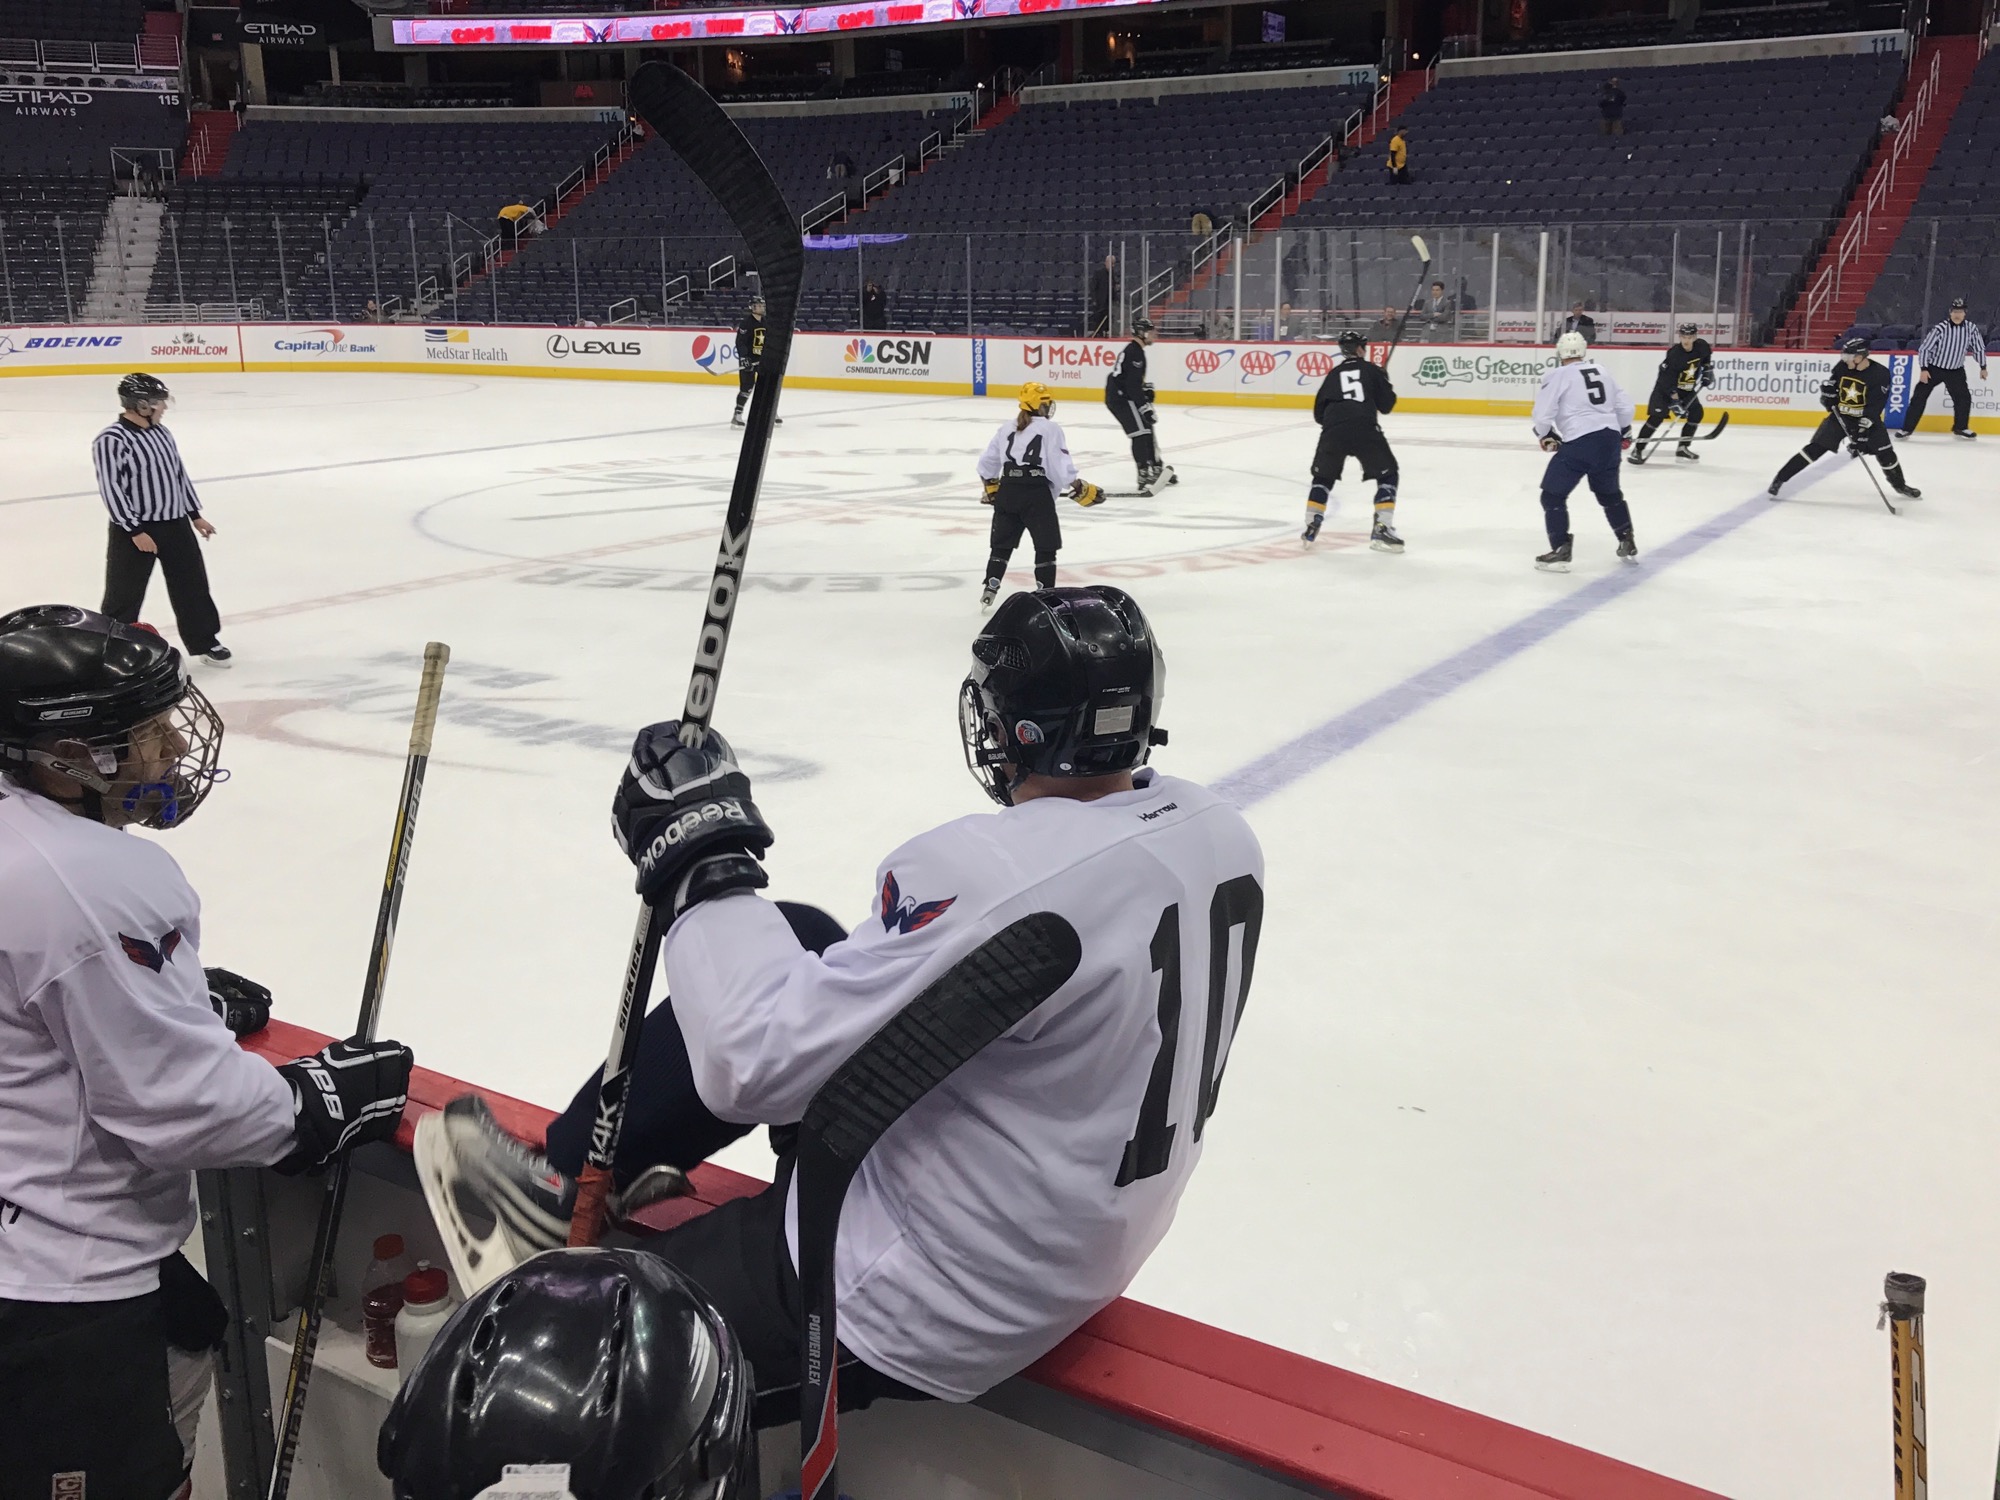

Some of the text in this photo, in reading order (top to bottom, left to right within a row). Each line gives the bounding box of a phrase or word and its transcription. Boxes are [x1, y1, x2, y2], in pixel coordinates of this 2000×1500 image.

[837, 10, 875, 29] CAPS
[244, 23, 317, 36] ETIHAD
[451, 27, 495, 43] CAPS
[651, 22, 692, 39] CAPS
[259, 37, 305, 45] AIRWAYS
[1871, 37, 1896, 51] 111
[1347, 71, 1370, 85] 112
[0, 91, 93, 105] ETIHAD
[158, 95, 180, 106] 115
[15, 107, 77, 117] AIRWAYS
[600, 112, 619, 123] 114
[25, 336, 122, 348] BOEING
[150, 345, 228, 356] SHOP.NHL.COM
[350, 344, 376, 353] Bank
[571, 341, 641, 355] LEXUS
[426, 347, 508, 362] MedStar Health
[876, 339, 932, 365] CSN
[974, 339, 987, 384] Reebok
[1048, 344, 1117, 367] McAfe
[1187, 350, 1218, 373] AAA
[845, 366, 930, 376] CSNMIDATLANTIC.COM
[1242, 351, 1273, 374] AAA
[1298, 353, 1332, 376] AAA
[1452, 356, 1474, 370] the
[1475, 356, 1545, 380] Greene
[1775, 359, 1831, 374] virginia
[1049, 370, 1081, 380] by Intel
[1707, 374, 1829, 394] orthodontic
[1889, 355, 1909, 414] Reebok
[1340, 369, 1365, 403] 5
[1579, 368, 1607, 406] 5
[1706, 394, 1790, 405] CAPSORTHO.COM
[1005, 431, 1043, 466] 14
[678, 522, 753, 749] eebok
[1137, 802, 1178, 822] Harrow
[640, 800, 749, 877] Reebok
[1114, 873, 1264, 1188] 10
[297, 1057, 345, 1121] BAU
[588, 1093, 620, 1169] 14K
[808, 1313, 821, 1386] POWER FLEX
